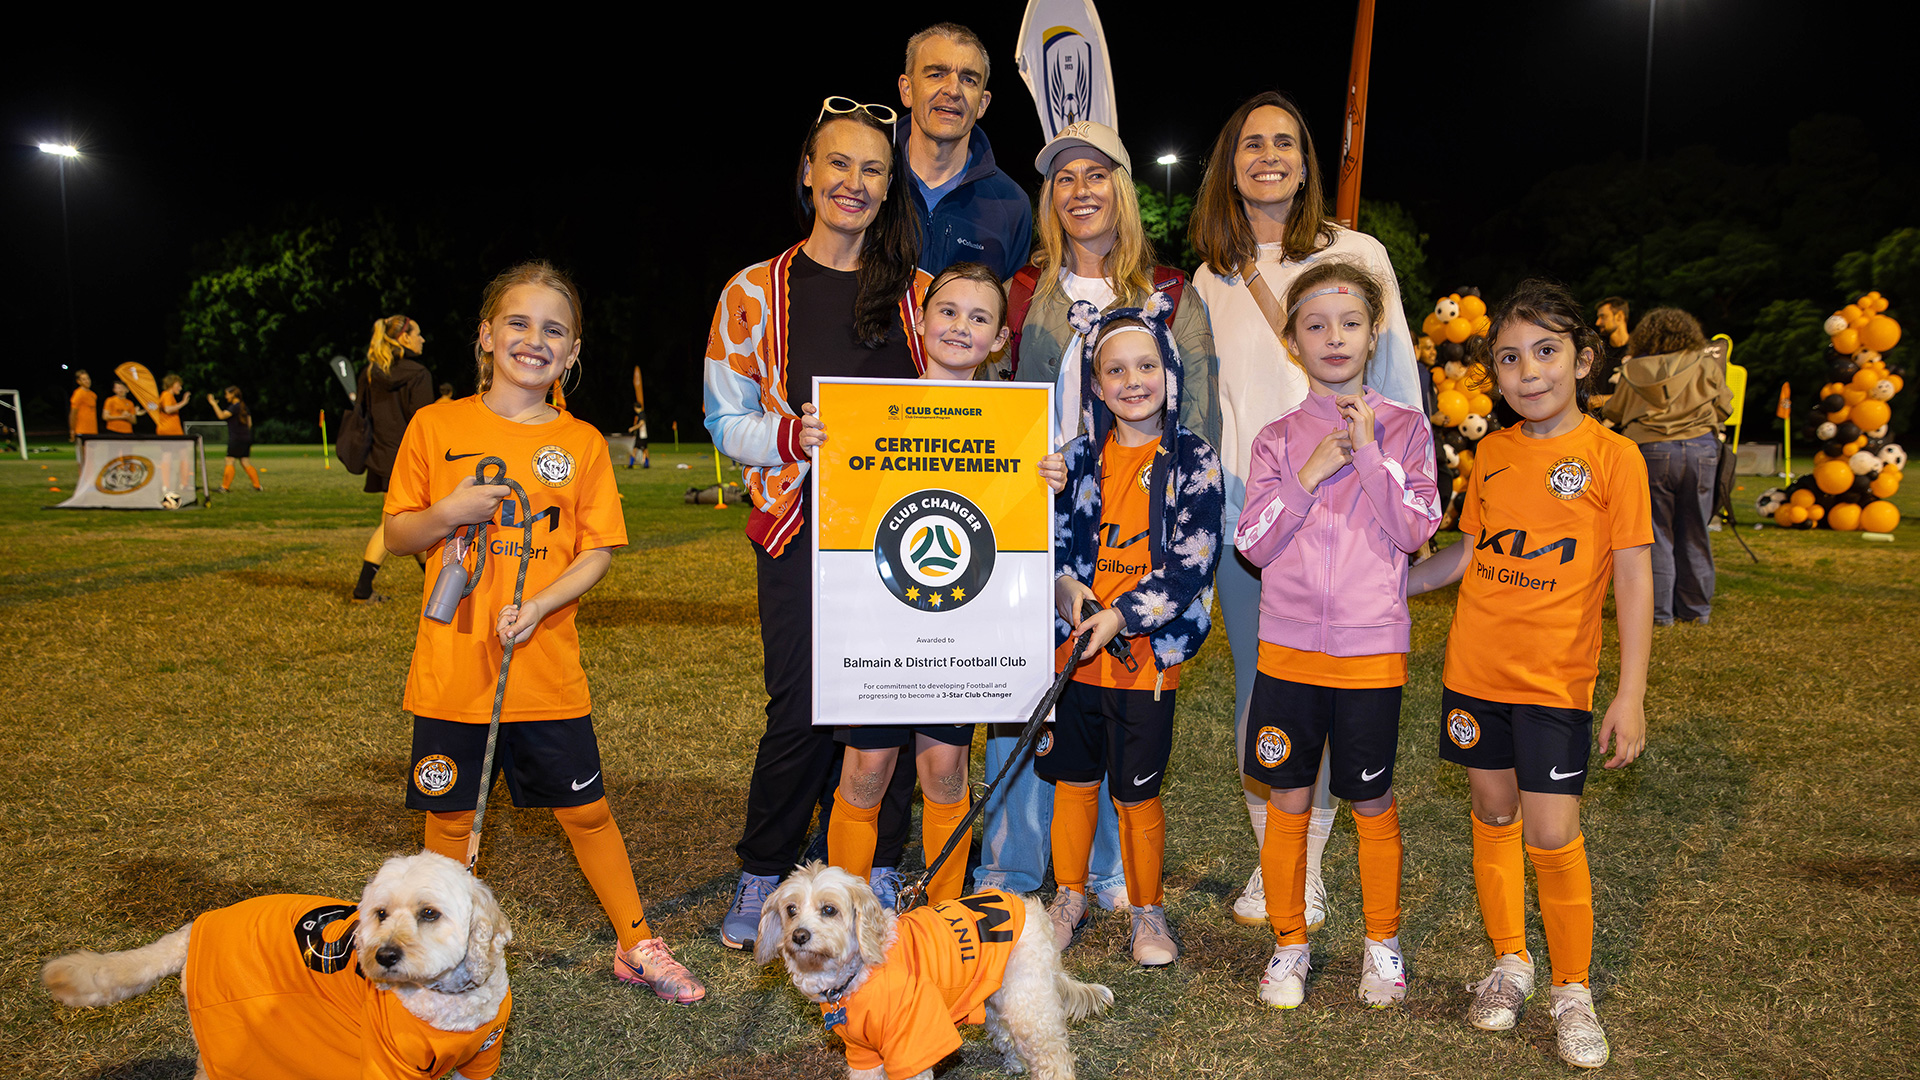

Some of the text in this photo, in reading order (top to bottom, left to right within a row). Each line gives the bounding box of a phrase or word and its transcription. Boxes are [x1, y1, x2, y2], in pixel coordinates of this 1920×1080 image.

[1067, 121, 1091, 138] NY
[905, 406, 982, 416] CLUB CHANGER
[875, 438, 995, 454] CERTIFICATE
[849, 456, 1020, 472] OF ACHIEVEMENT
[889, 498, 982, 532] CLUB CHANGER
[490, 540, 548, 560] Gilbert
[1097, 559, 1148, 575] Gilbert
[1476, 562, 1557, 592] Phil Gilbert
[844, 656, 1027, 668] Balmain & District Football Club
[928, 682, 965, 690] developing
[944, 918, 975, 964] TINY
